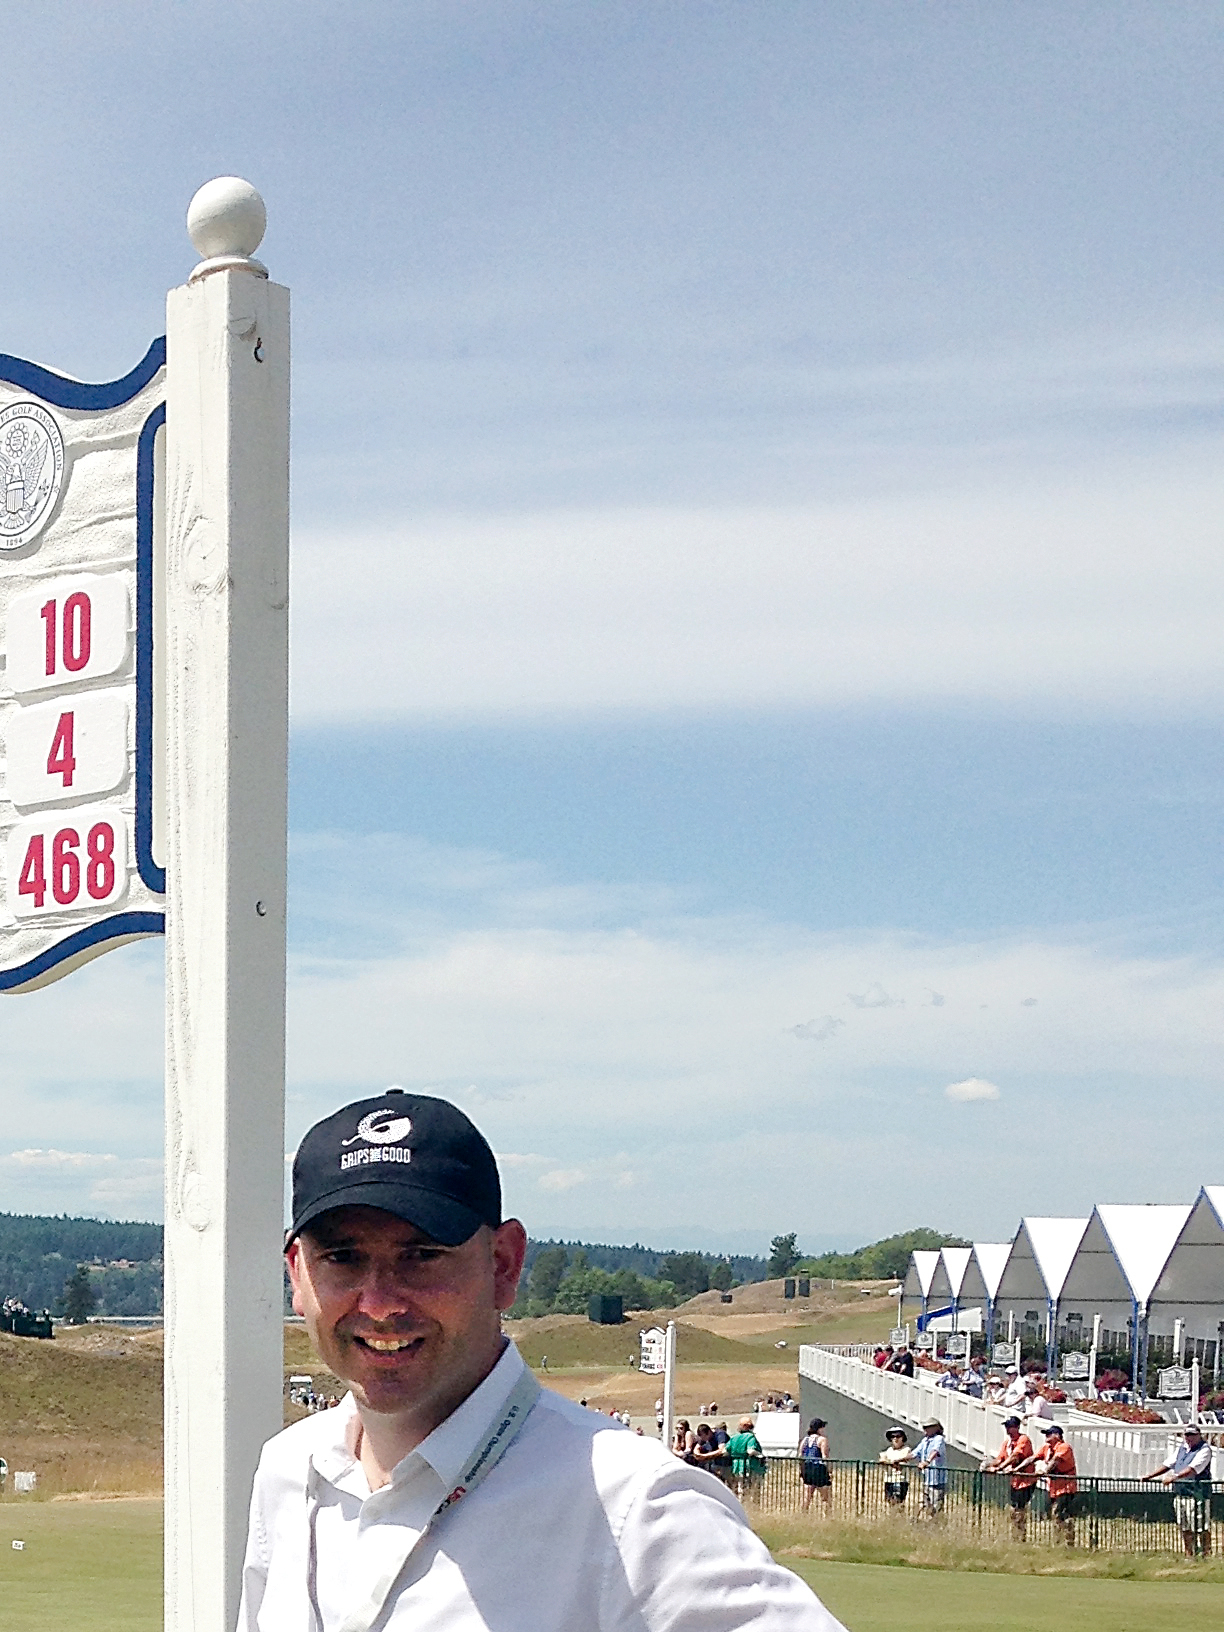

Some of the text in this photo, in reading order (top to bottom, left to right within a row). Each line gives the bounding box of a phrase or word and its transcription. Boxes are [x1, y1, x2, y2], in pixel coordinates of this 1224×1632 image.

[12, 406, 32, 417] GOLF
[33, 409, 63, 471] ASSOCIATION
[6, 538, 23, 547] 1894
[42, 593, 90, 675] 10
[48, 713, 75, 786] 4
[19, 823, 114, 907] 468
